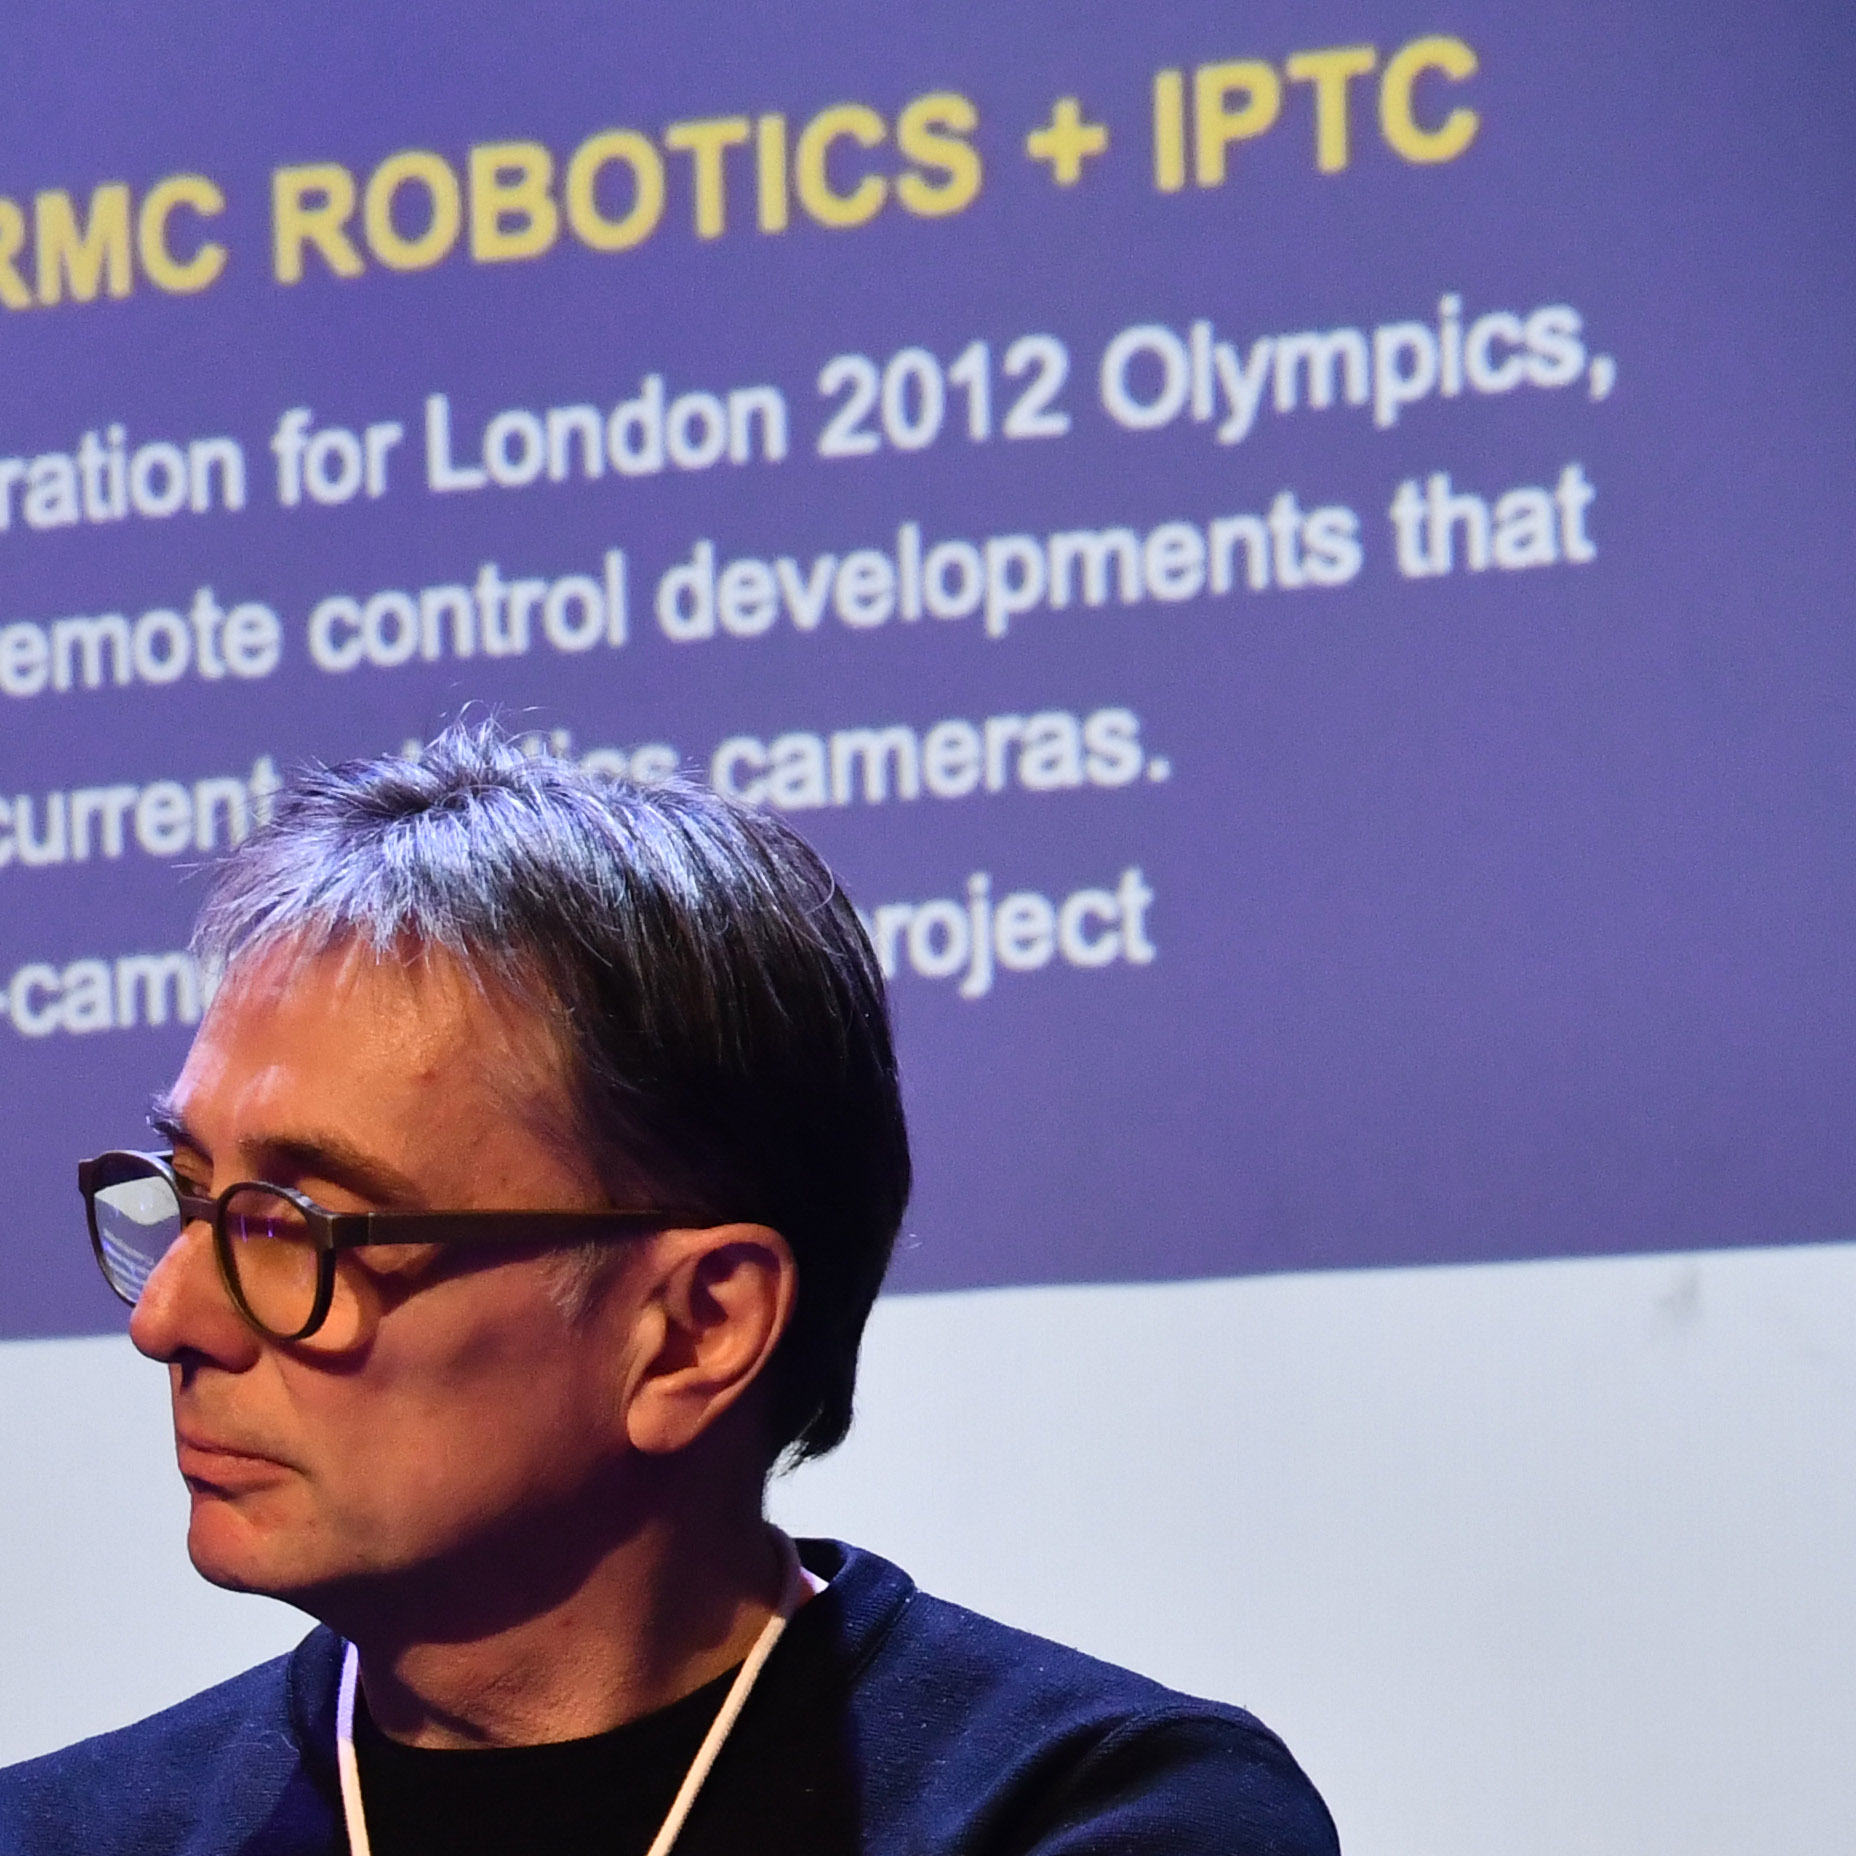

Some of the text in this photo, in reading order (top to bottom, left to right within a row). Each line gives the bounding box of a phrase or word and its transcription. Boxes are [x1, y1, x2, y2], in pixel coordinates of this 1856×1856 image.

[272, 91, 983, 283] ROBOTICS
[1025, 98, 1108, 185] +
[1153, 36, 1479, 192] IPTC
[270, 408, 404, 506] for
[425, 374, 788, 492] London
[817, 335, 1072, 458] 2012
[1099, 294, 1616, 445] Olympics,
[307, 548, 628, 672] control
[654, 491, 1365, 642] developments
[1388, 463, 1597, 579] that
[712, 706, 1172, 812] cameras.
[859, 867, 1157, 999] roject
